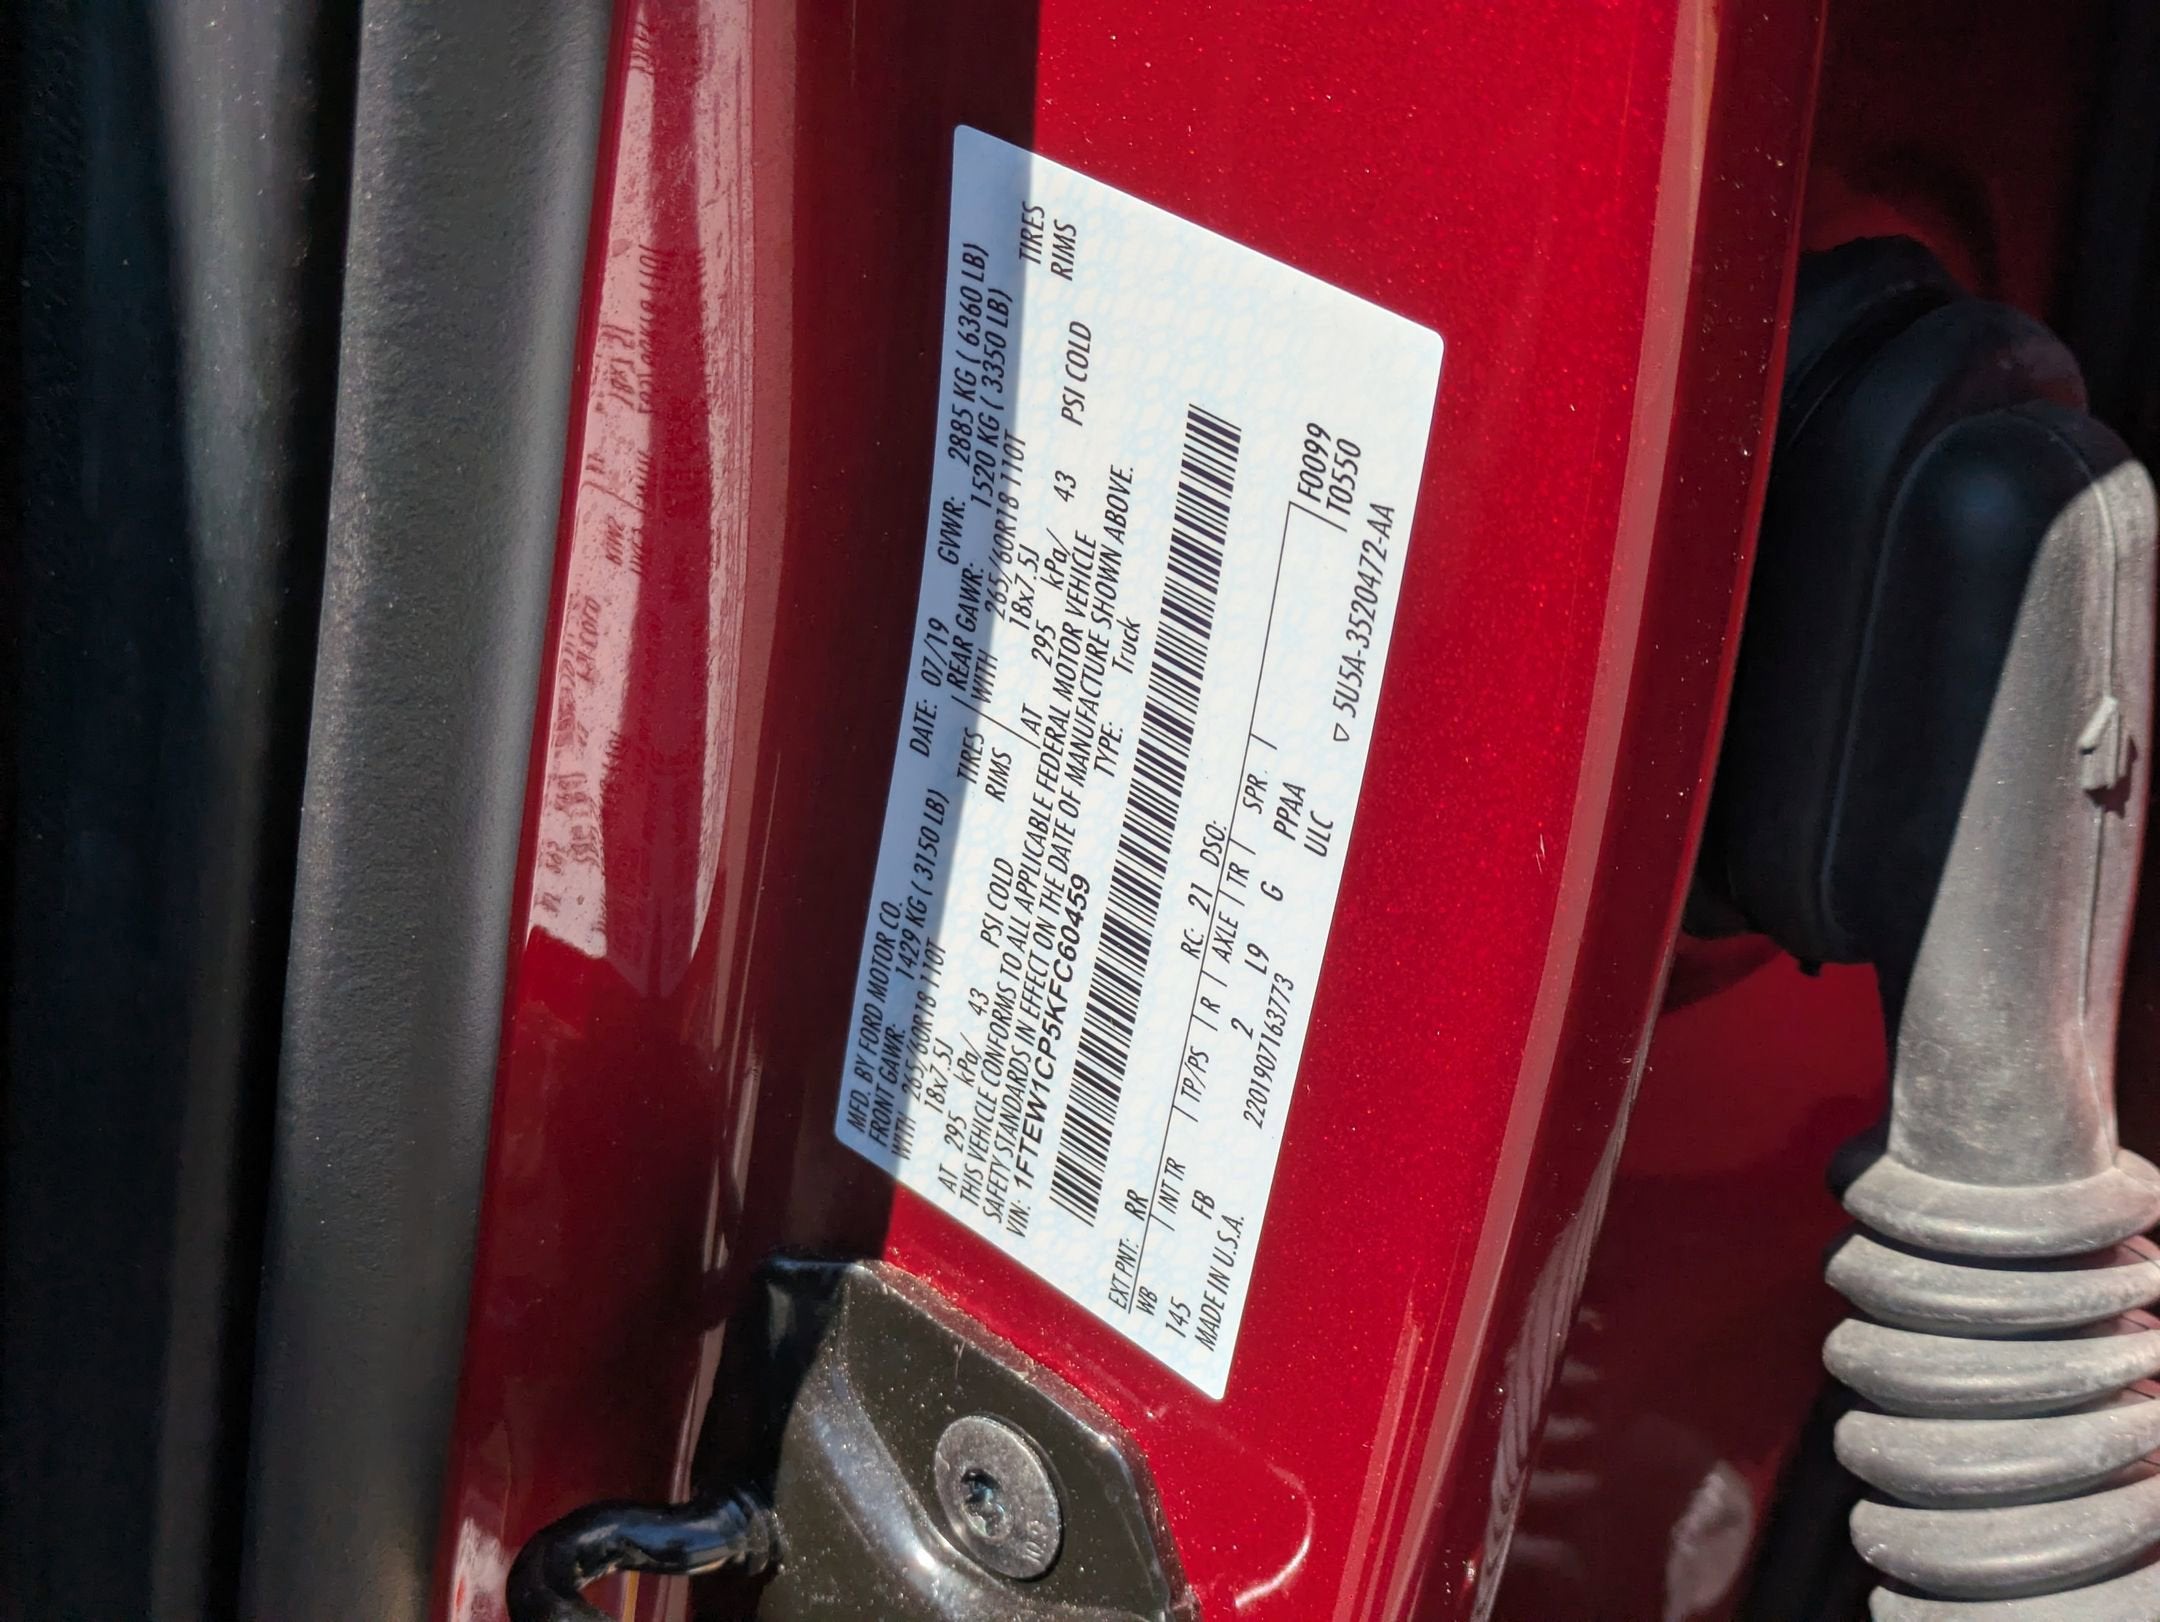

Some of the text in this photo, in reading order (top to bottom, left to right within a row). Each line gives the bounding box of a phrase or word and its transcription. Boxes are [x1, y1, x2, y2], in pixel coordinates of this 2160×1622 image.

[960, 242, 989, 282] LB)
[957, 285, 982, 346] 6360
[985, 287, 1013, 328] LB)
[952, 366, 976, 403] KG
[980, 330, 1006, 393] 3350
[947, 403, 973, 466] 2885
[970, 200, 1044, 703] WITH 265/60R18 110T TIRES
[976, 411, 999, 448] KG
[1008, 218, 1076, 630] 18x7.5J RIMS
[970, 449, 996, 508] 1520
[1296, 422, 1331, 503] F0099
[1325, 438, 1361, 515] T0550
[937, 496, 965, 565] GVWR:
[1020, 320, 1091, 736] AT 295 kPa/ 43 PSI COLD
[955, 562, 984, 632] GAWR:
[1332, 503, 1394, 718] 5U5A-3520472-AA
[909, 617, 949, 757] DATE: 07/19
[946, 634, 973, 691] REAR
[1093, 616, 1140, 777] TYPE: Truck
[922, 788, 949, 825] LB)
[1273, 781, 1305, 840] PPAA
[1303, 810, 1333, 857] ULC
[913, 825, 940, 881] 3150
[959, 529, 1096, 1206] THIS VEHICLE CONFORMS TO ALL APPLICABLE FEDERAL MOTOR VEHICLE
[982, 464, 1133, 1223] SAFETY STANDARDS IN EFFECT ON THE DATE OF MANUFACTURE SHOWN ABOVE.
[1199, 820, 1226, 867] DSO:
[1225, 861, 1249, 888] TR
[1260, 880, 1283, 901] G
[904, 895, 927, 928] KG
[924, 746, 1011, 1113] 18x7.5J RIMS
[1180, 882, 1212, 959] RC: 21
[1211, 910, 1238, 964] AXLE
[891, 726, 984, 1160] WITH 265/60R18 110T TIRES
[895, 927, 921, 980] 1429
[1244, 942, 1269, 975] L9
[846, 900, 902, 1133] MFD. BY FORD MOTOR CO.
[937, 857, 1013, 1193] AT 295 kPa/ 43 PSI COLD
[1199, 995, 1220, 1014] R
[1230, 1017, 1253, 1039] 2
[877, 1023, 905, 1084] GAWR:
[1006, 865, 1090, 1237] VIN: 1FTEW1CP5KFC60459
[1180, 1045, 1209, 1102] TP/PS
[1242, 972, 1293, 1128] 2201907163773
[868, 1082, 894, 1147] FRONT
[1157, 1156, 1185, 1214] INT TR
[1191, 1189, 1214, 1219] FB
[1108, 1188, 1148, 1309] EXT PNT: RR
[1135, 1285, 1157, 1315] WB
[1194, 1214, 1244, 1351] MADE IN U.S.A.
[1165, 1295, 1191, 1338] 145
